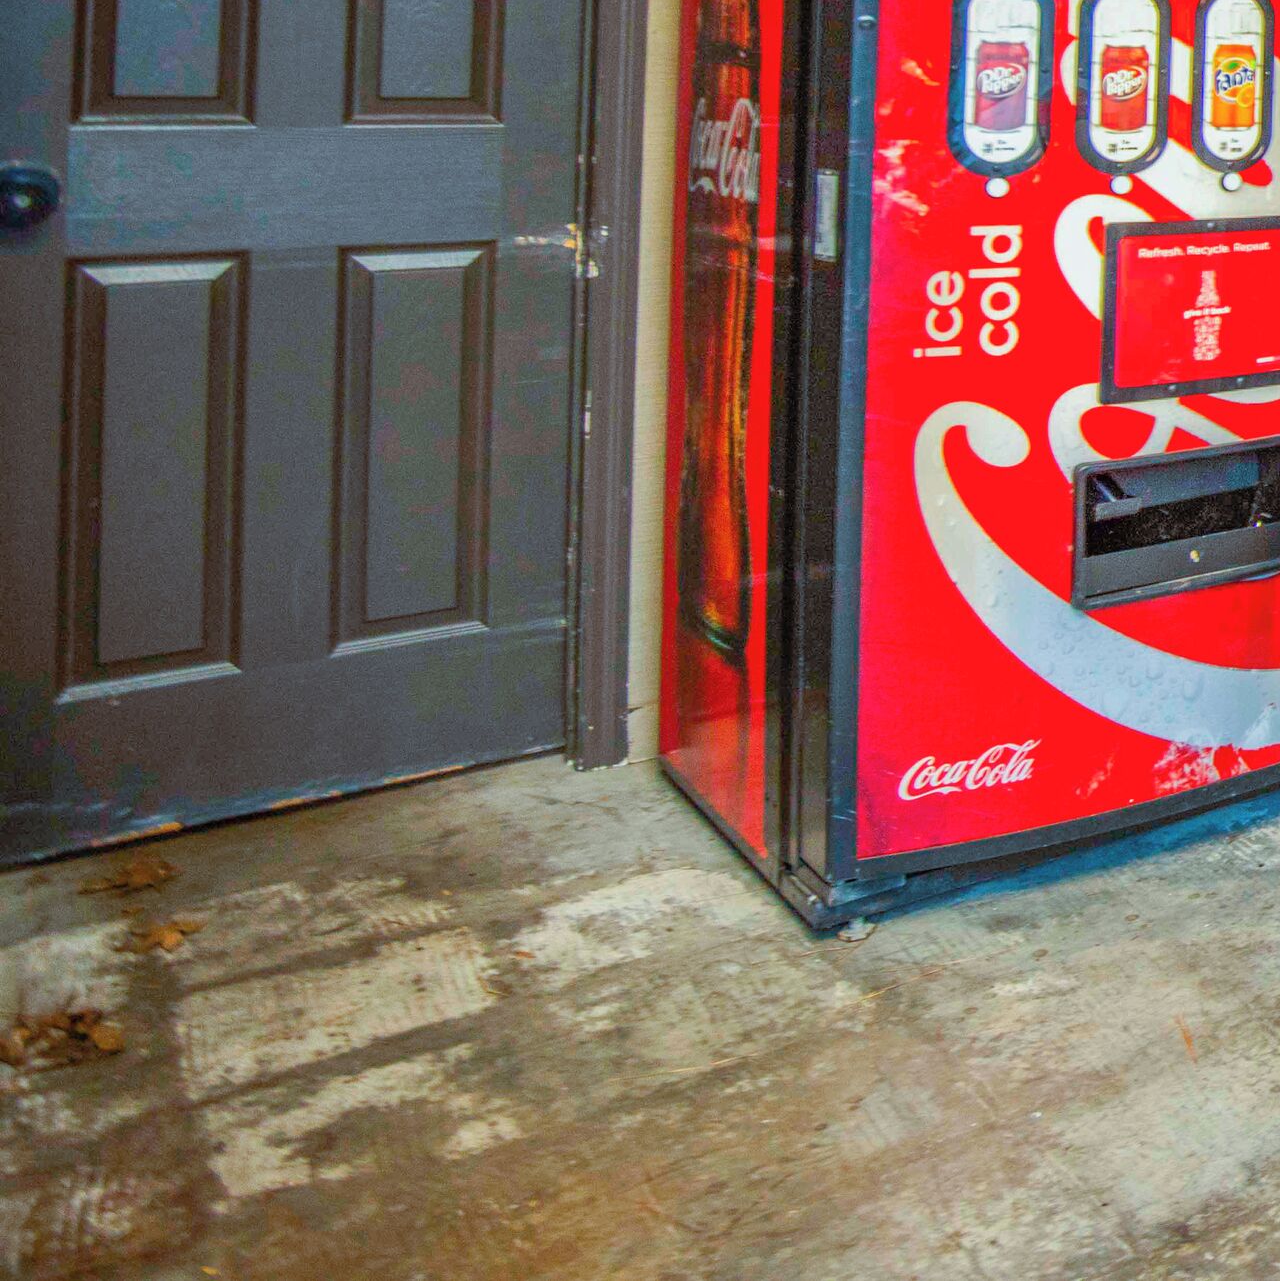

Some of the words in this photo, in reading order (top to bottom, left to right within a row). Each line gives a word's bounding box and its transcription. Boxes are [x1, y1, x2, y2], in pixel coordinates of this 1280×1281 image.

[1137, 246, 1185, 259] Refresh.
[1233, 242, 1271, 252] Repeat.
[913, 270, 965, 358] ice
[968, 224, 1023, 356] cold
[898, 739, 1042, 801] Coca-Cola
